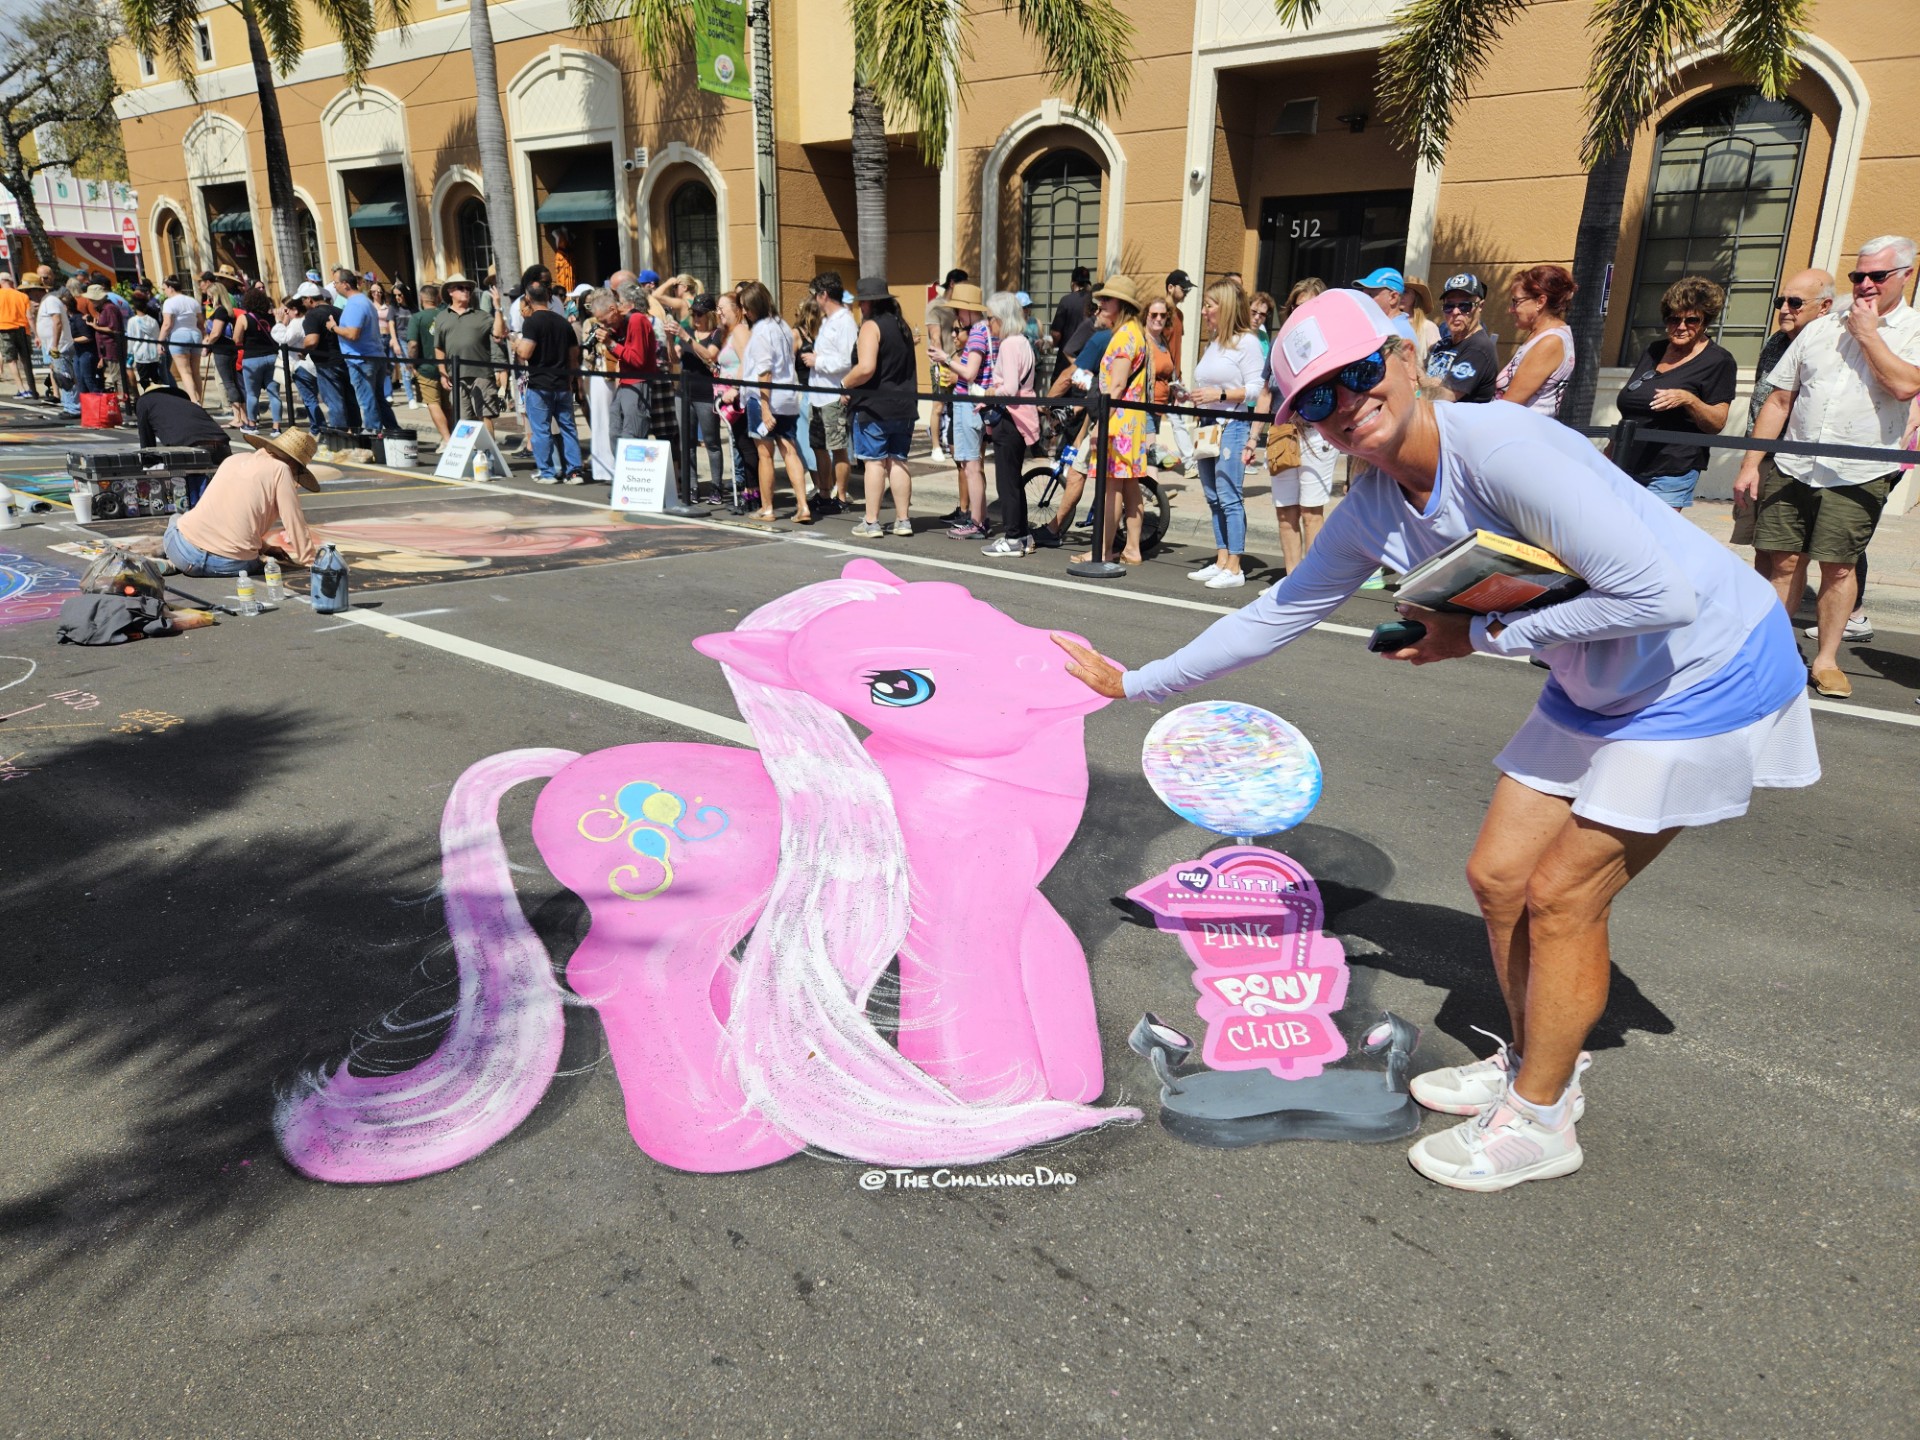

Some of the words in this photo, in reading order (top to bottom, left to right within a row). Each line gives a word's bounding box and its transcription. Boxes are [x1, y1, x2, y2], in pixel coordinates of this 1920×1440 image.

[1290, 218, 1321, 239] 512
[621, 484, 655, 493] Mesmer
[626, 475, 652, 484] Shane
[1177, 870, 1209, 888] my
[1200, 922, 1280, 950] PINK
[1227, 1020, 1312, 1052] CLUB
